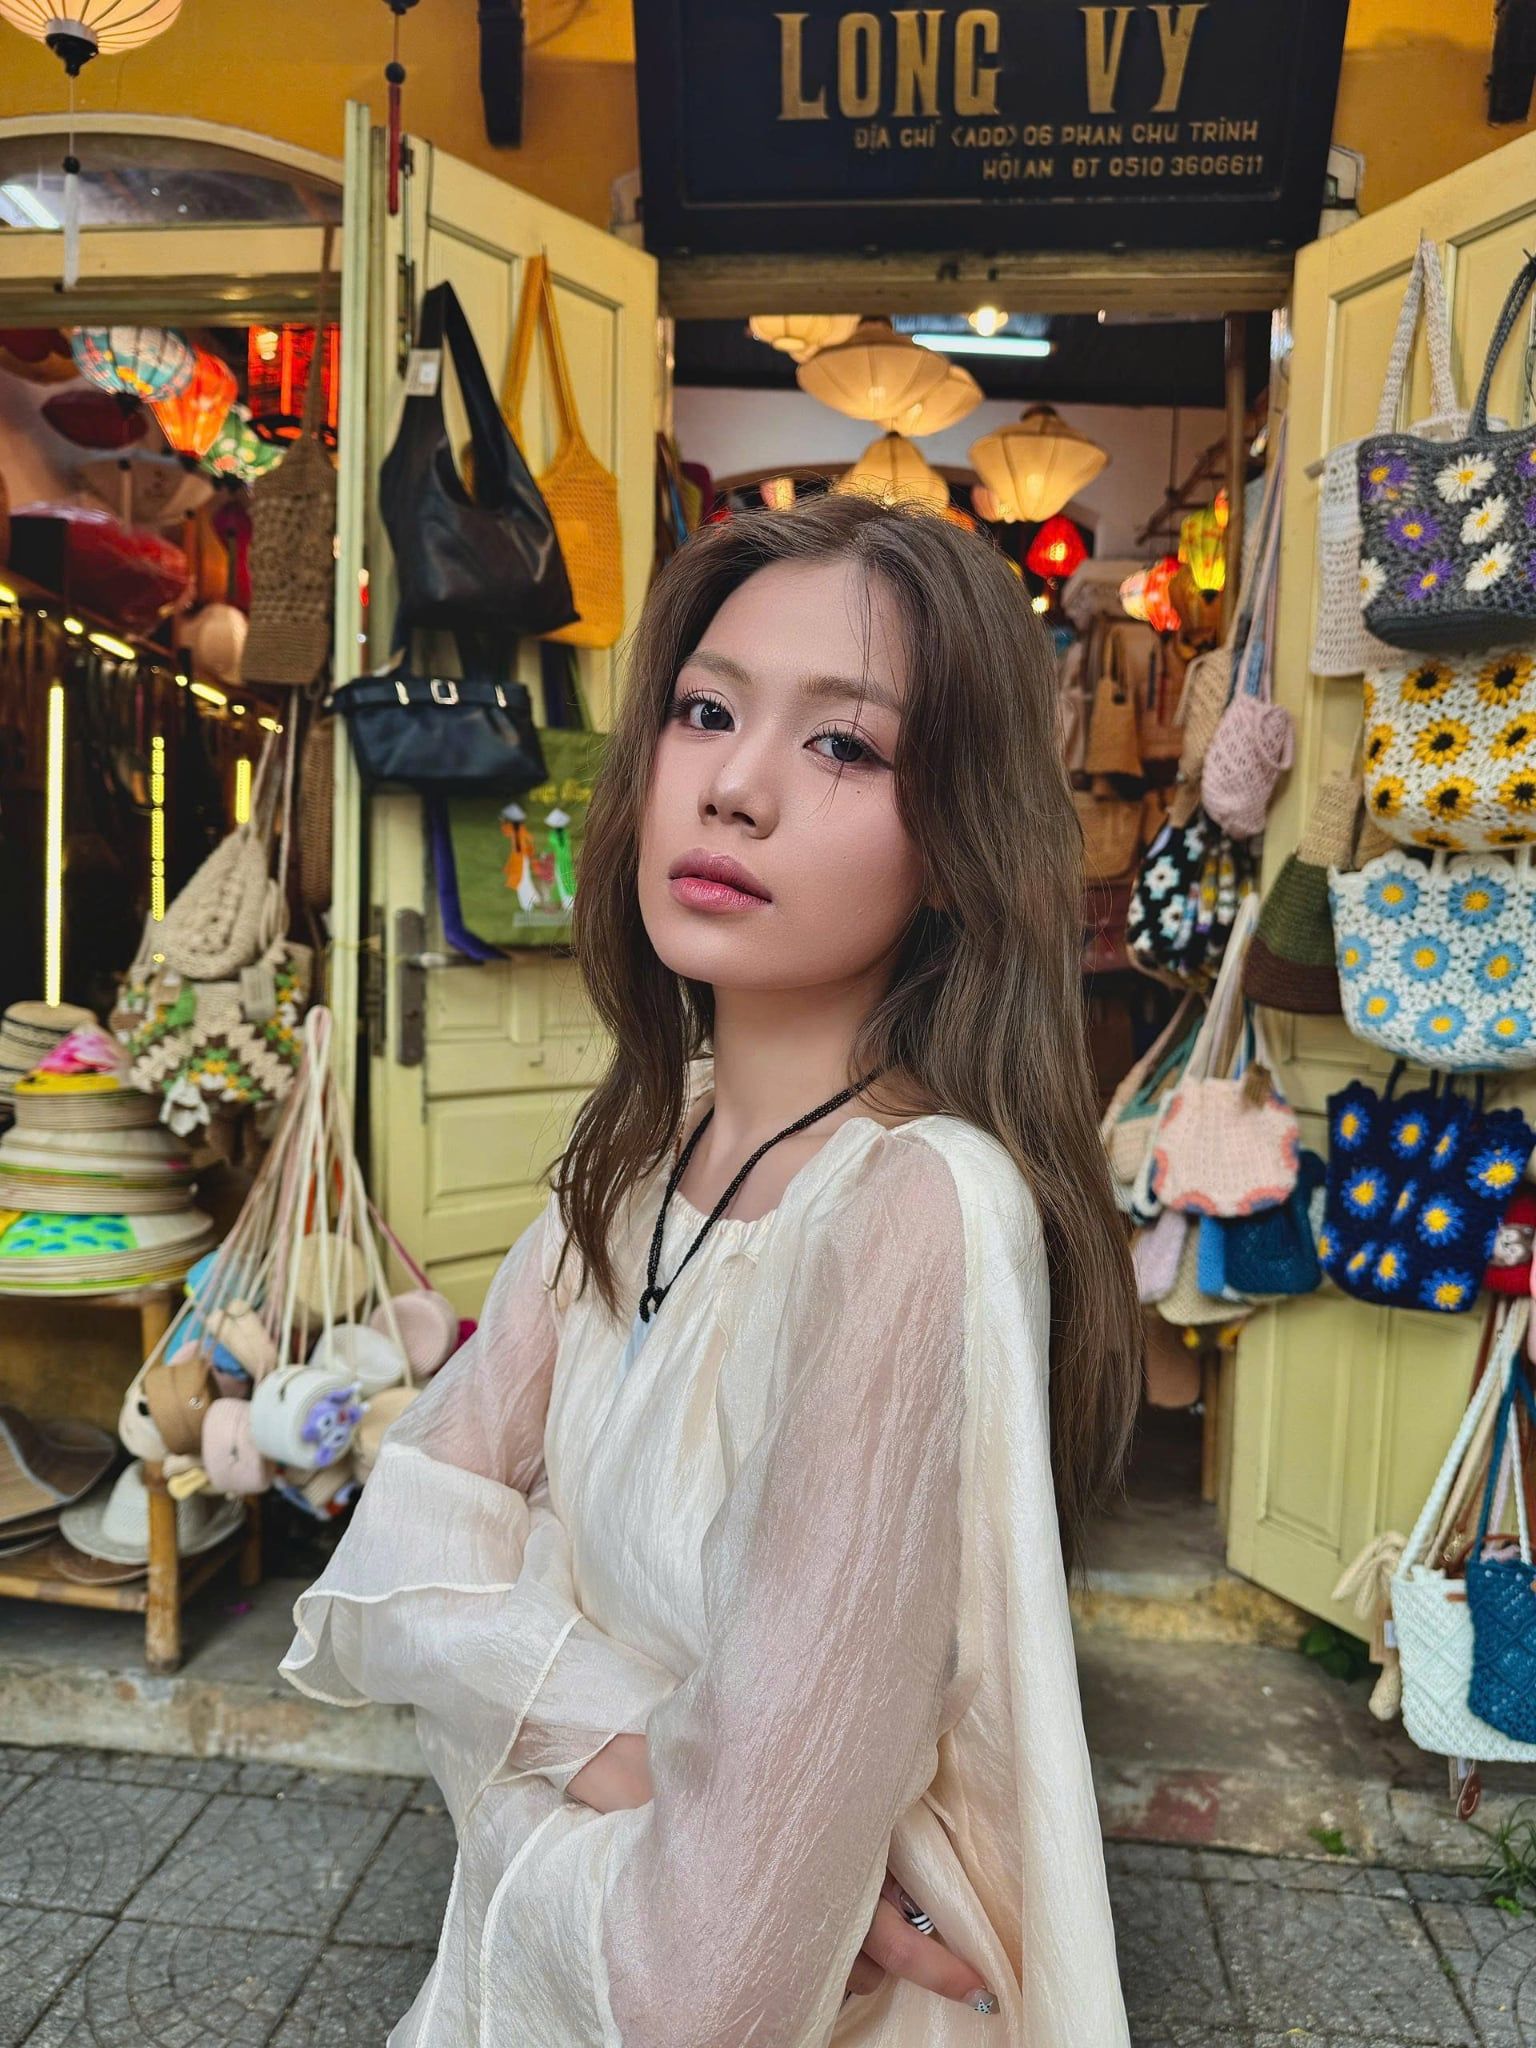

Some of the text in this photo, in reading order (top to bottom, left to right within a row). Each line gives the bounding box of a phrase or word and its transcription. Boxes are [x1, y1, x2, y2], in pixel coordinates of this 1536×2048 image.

[773, 3, 1209, 121] LONG VY
[1023, 124, 1054, 146] 06
[1060, 123, 1123, 145] PHAN
[1131, 122, 1179, 144] CHU
[1188, 116, 1259, 143] TRÌNH
[1108, 155, 1164, 177] 0510
[1170, 153, 1264, 176] 3606611
